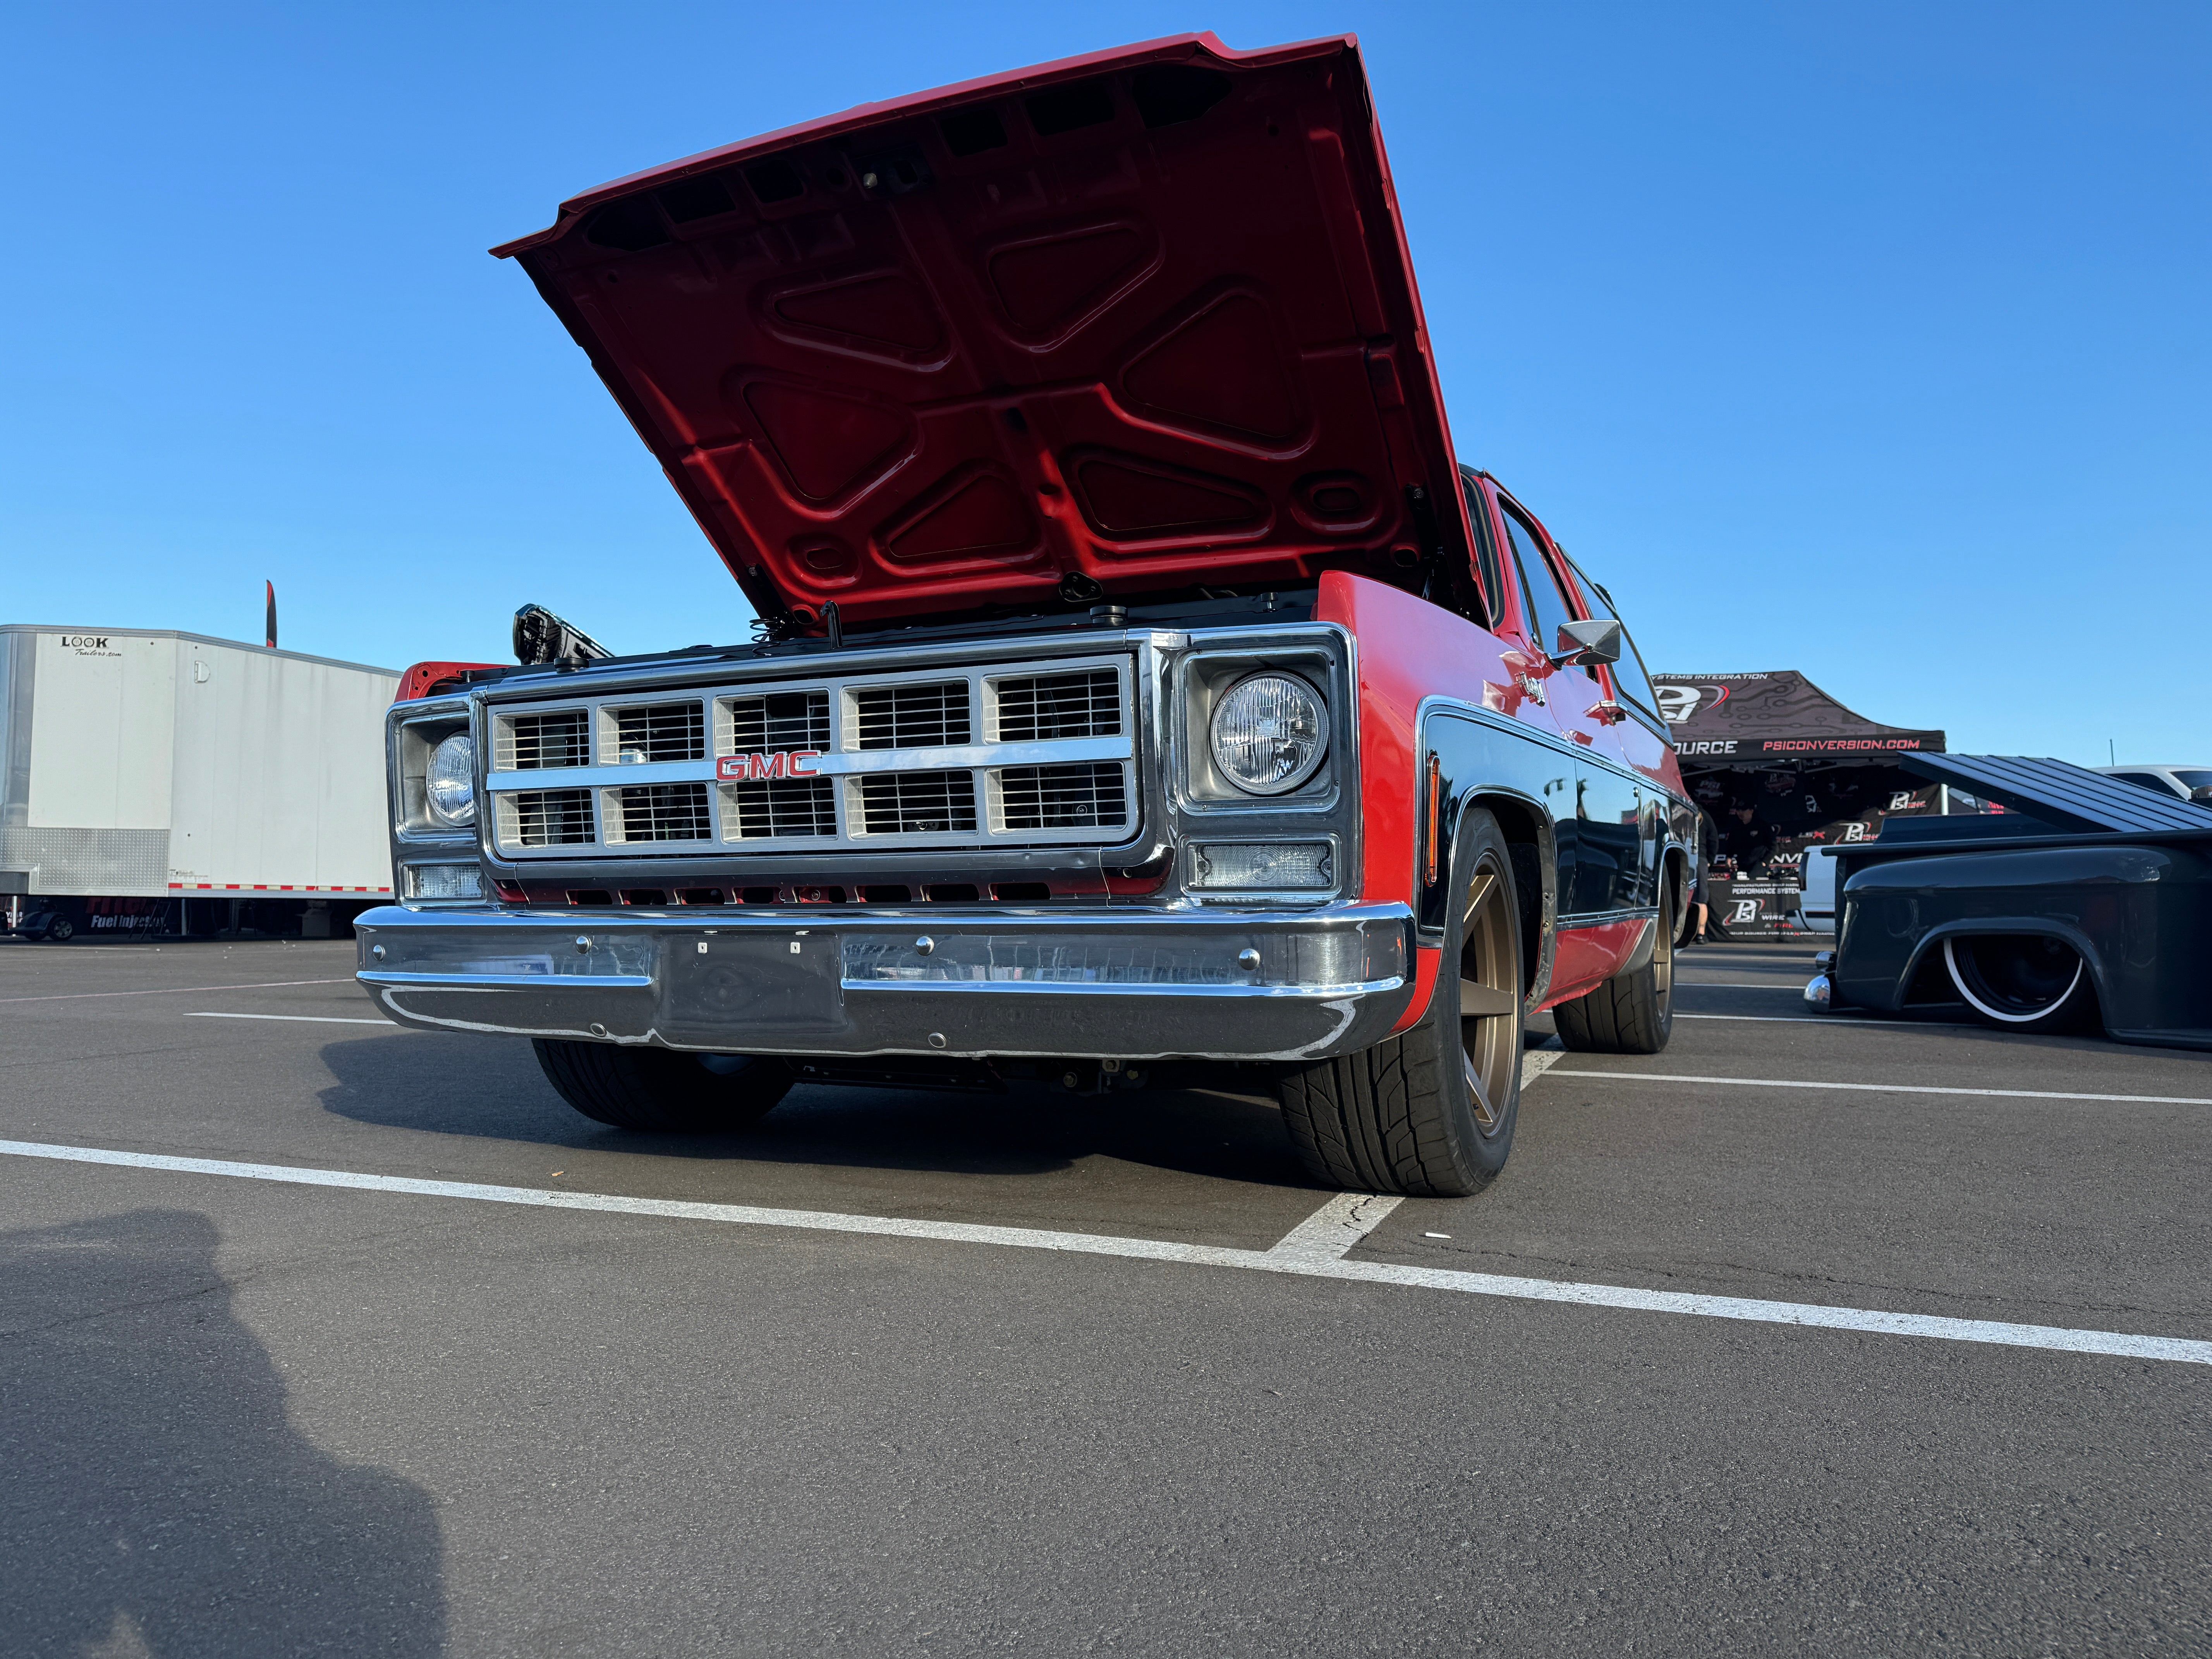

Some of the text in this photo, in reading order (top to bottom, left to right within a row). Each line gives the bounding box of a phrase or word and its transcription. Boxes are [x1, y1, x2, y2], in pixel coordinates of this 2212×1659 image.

[61, 636, 109, 648] LOOK
[75, 649, 122, 657] Trailers.com
[1673, 740, 1738, 755] OURCE
[1763, 740, 1920, 751] PSICONVERSION.COM
[716, 750, 822, 782] GMC
[91, 915, 117, 928] Fuel
